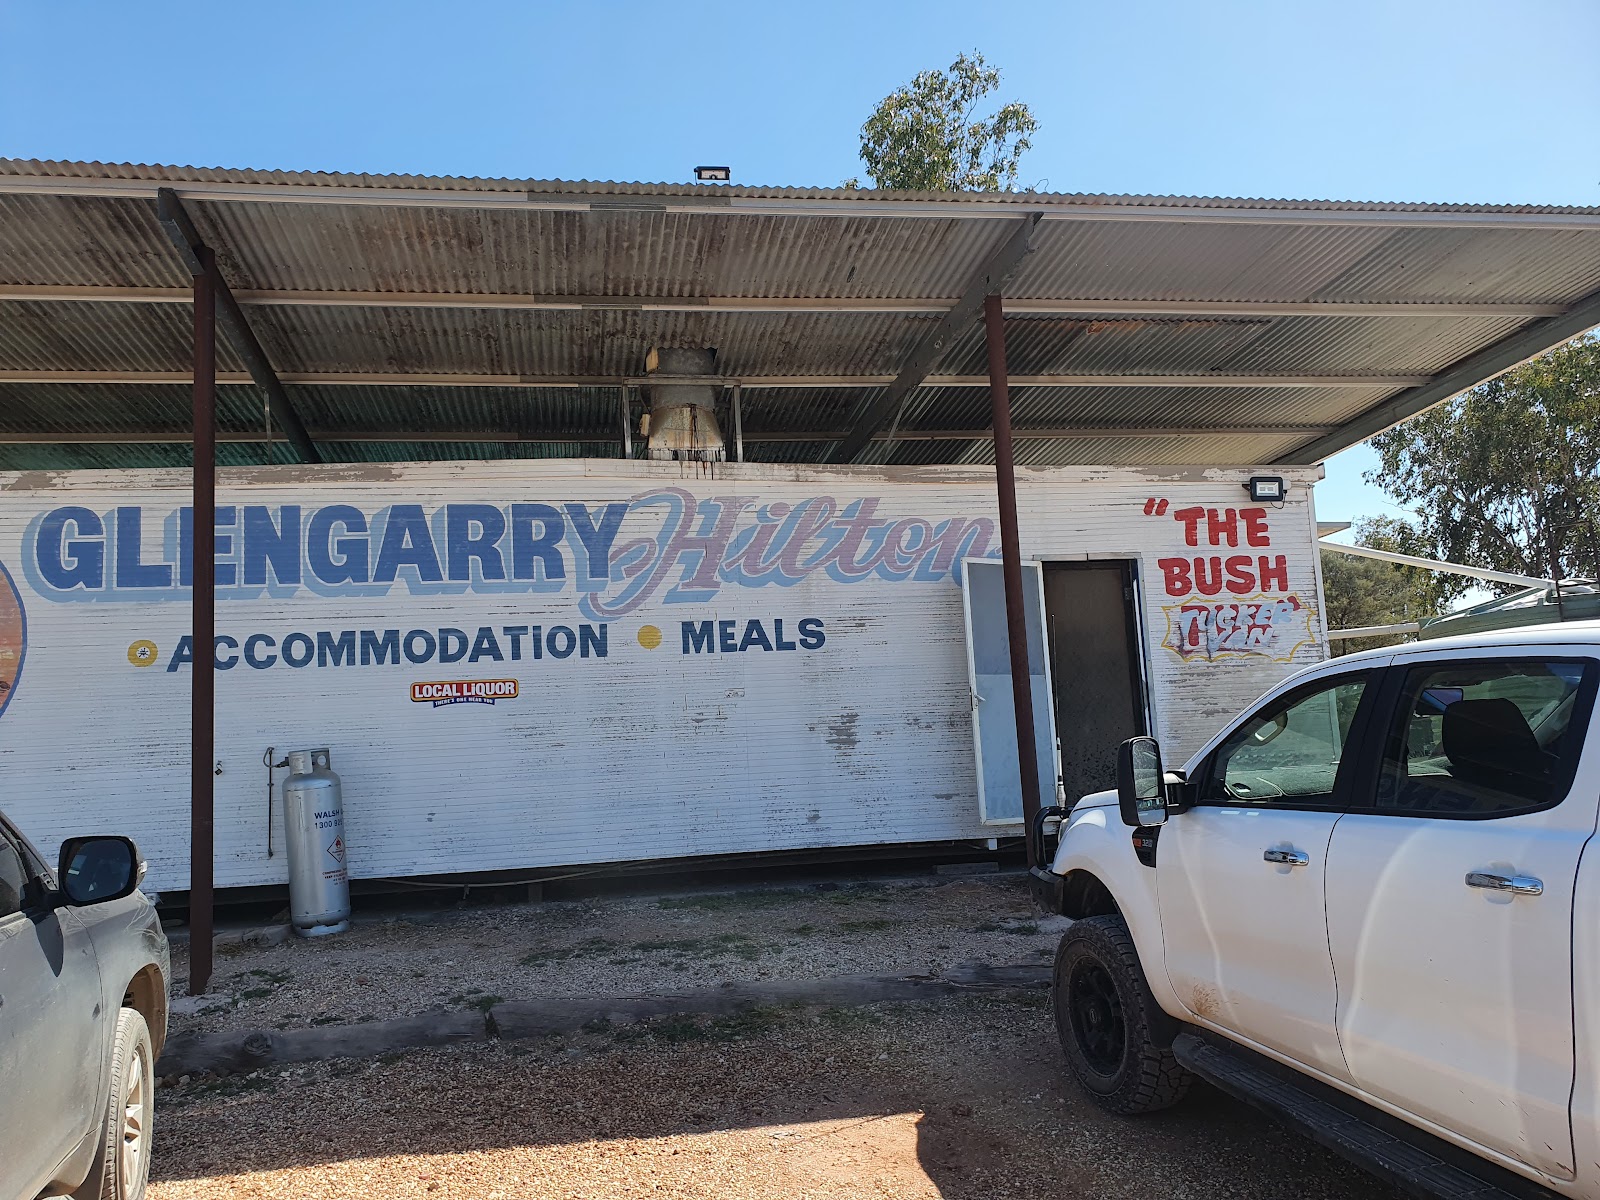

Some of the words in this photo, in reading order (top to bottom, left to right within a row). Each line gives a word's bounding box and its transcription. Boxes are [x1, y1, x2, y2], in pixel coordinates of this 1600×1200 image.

[34, 502, 630, 590] GLENGARRY
[587, 487, 999, 616] Hilton
[1157, 554, 1289, 597] BUSH
[166, 623, 609, 673] ACCOMMODATION
[681, 617, 827, 655] MEALS
[414, 683, 461, 699] LOCAL
[314, 809, 340, 820] WALSH
[315, 820, 333, 829] 1300
